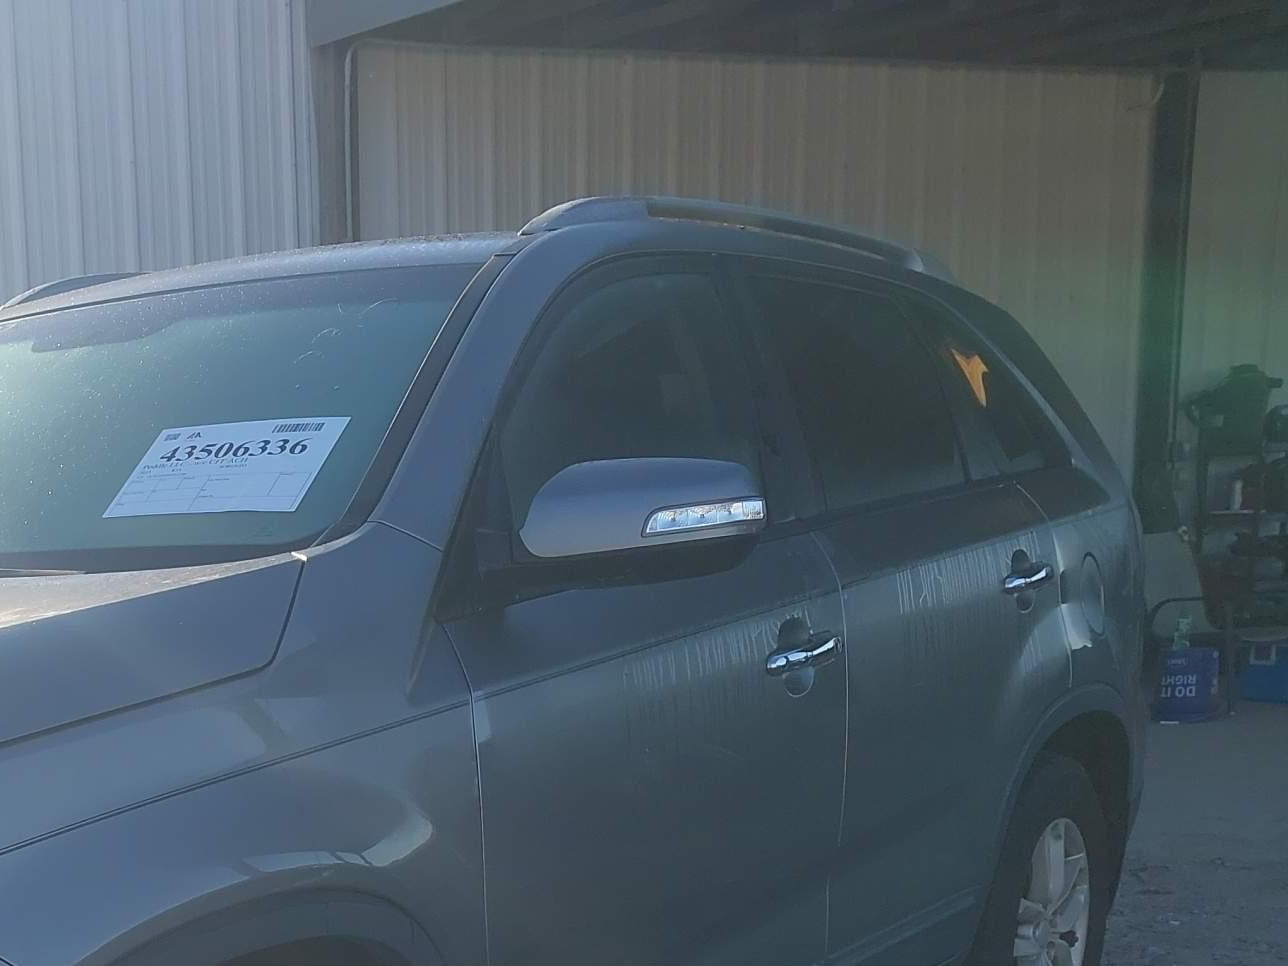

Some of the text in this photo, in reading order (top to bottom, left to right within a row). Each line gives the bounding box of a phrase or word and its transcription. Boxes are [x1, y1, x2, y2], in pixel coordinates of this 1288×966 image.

[159, 437, 313, 462] 43506336
[1160, 674, 1197, 685] RIGHT
[1160, 686, 1196, 698] DO IT
